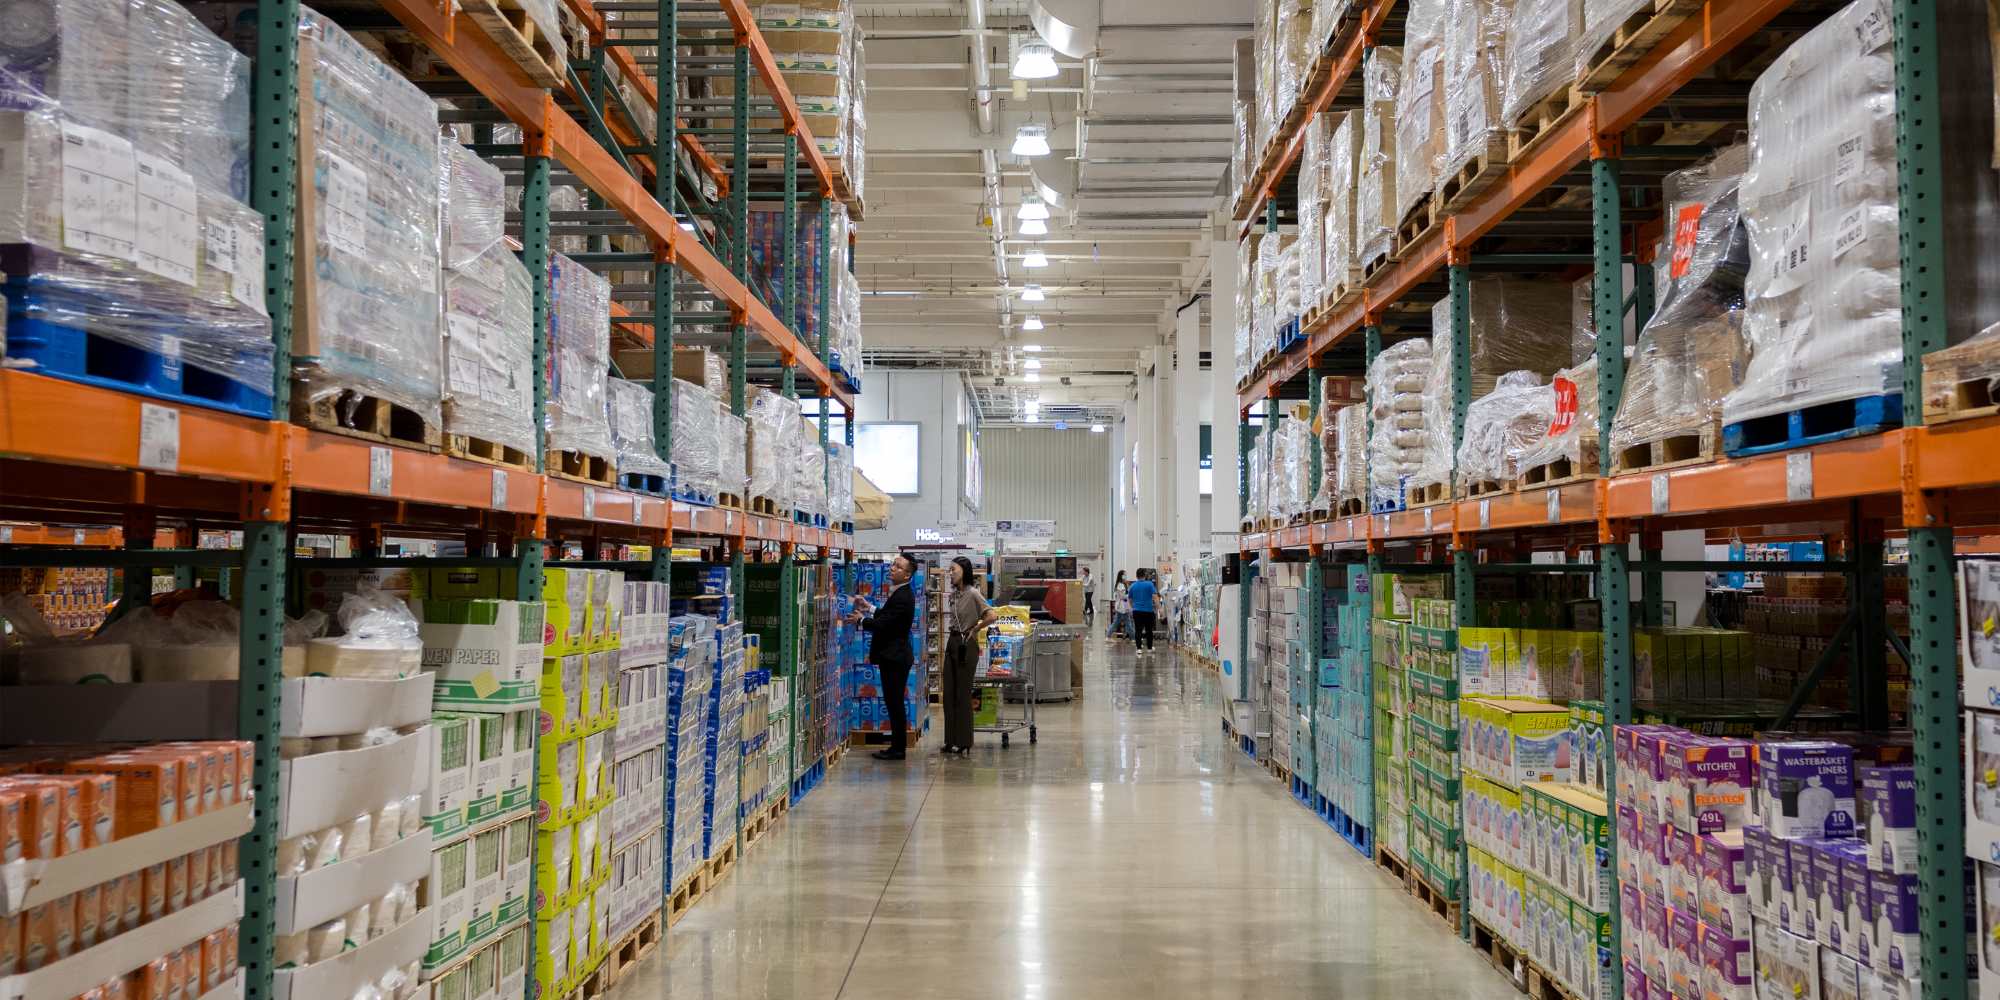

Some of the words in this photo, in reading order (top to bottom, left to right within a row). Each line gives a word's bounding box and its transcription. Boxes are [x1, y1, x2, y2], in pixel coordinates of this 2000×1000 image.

[455, 648, 500, 665] PAPER
[1696, 761, 1737, 772] KITCHEN
[1783, 756, 1847, 767] WASTEBASKET
[1817, 766, 1848, 775] LINERS
[1831, 812, 1846, 823] 10
